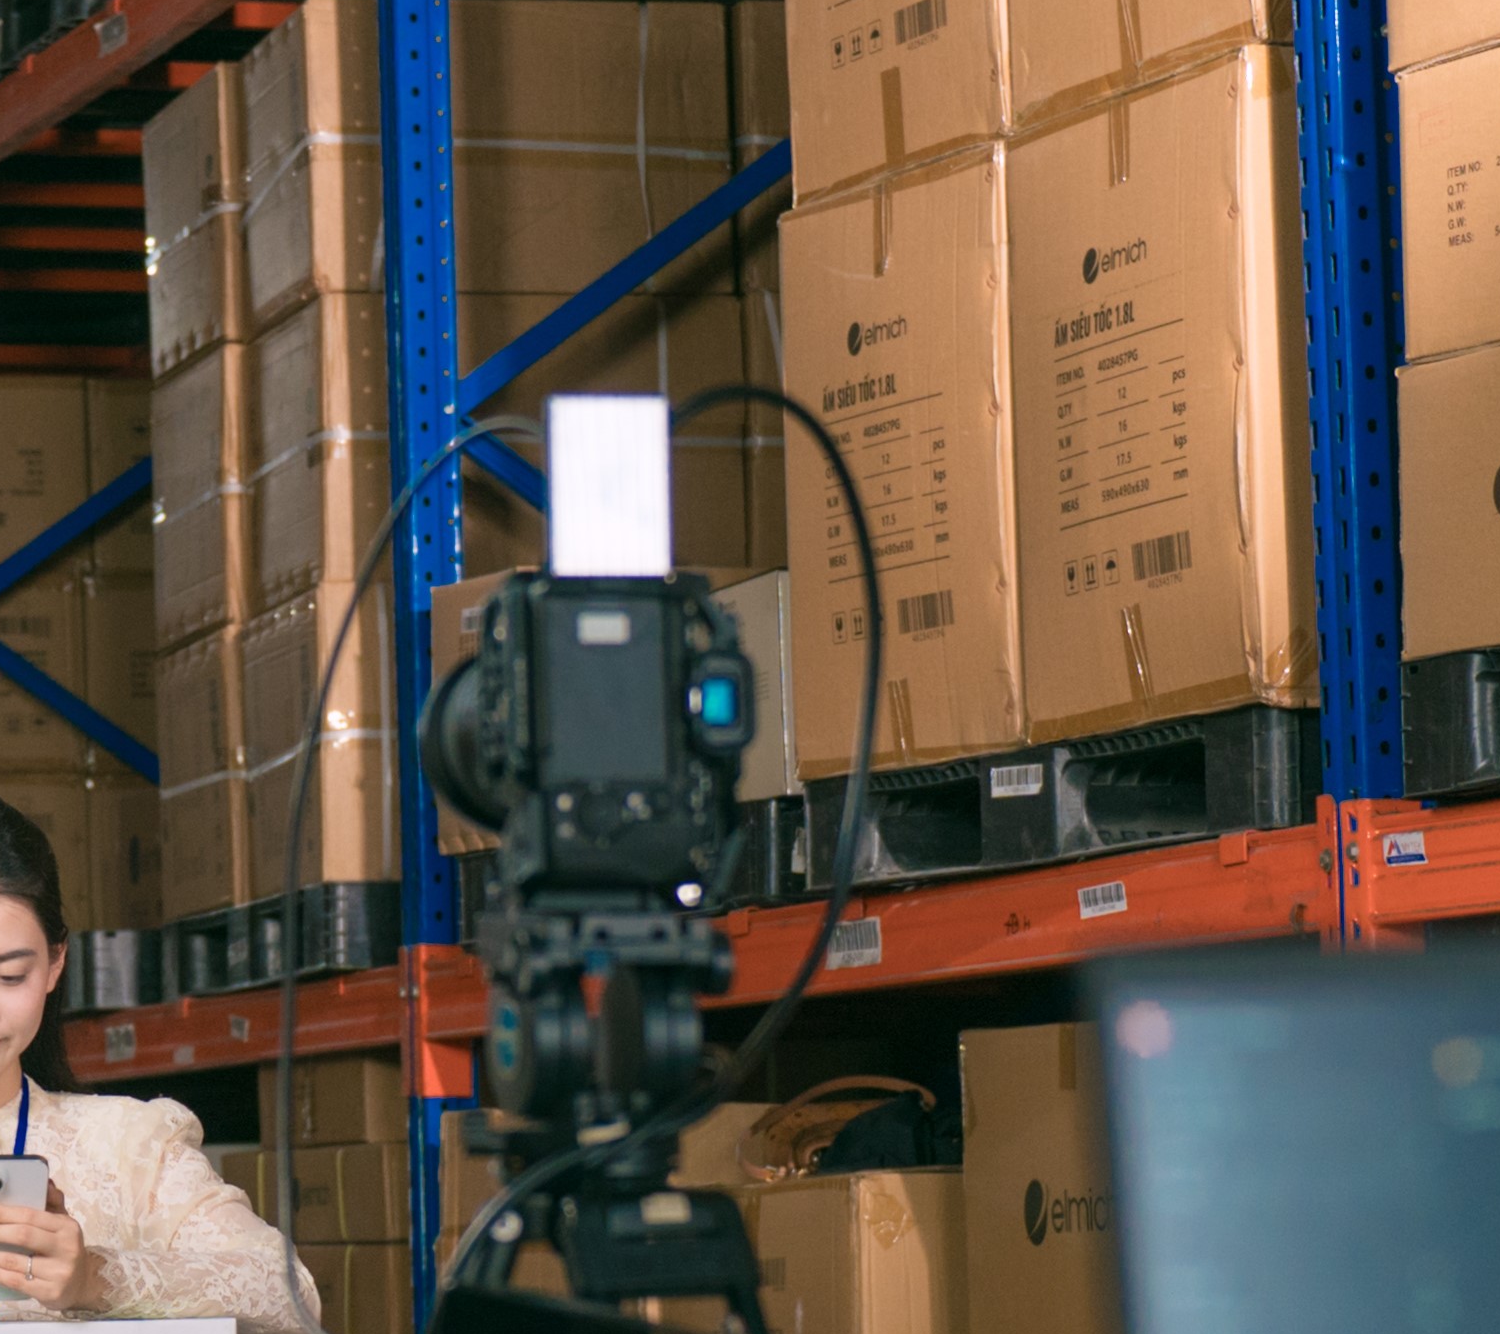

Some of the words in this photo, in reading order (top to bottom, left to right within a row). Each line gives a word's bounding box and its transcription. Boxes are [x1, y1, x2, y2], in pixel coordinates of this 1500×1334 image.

[1101, 237, 1147, 273] elmich
[864, 315, 907, 346] elmich
[1054, 317, 1068, 348] ẤM
[1070, 311, 1091, 343] SIÊU
[1094, 301, 1113, 334] TỐC
[1115, 300, 1135, 328] 1.8L
[822, 385, 835, 413] ẤM
[837, 380, 857, 410] SIÊU
[858, 373, 876, 404] TỐC
[877, 373, 897, 398] 1.8L
